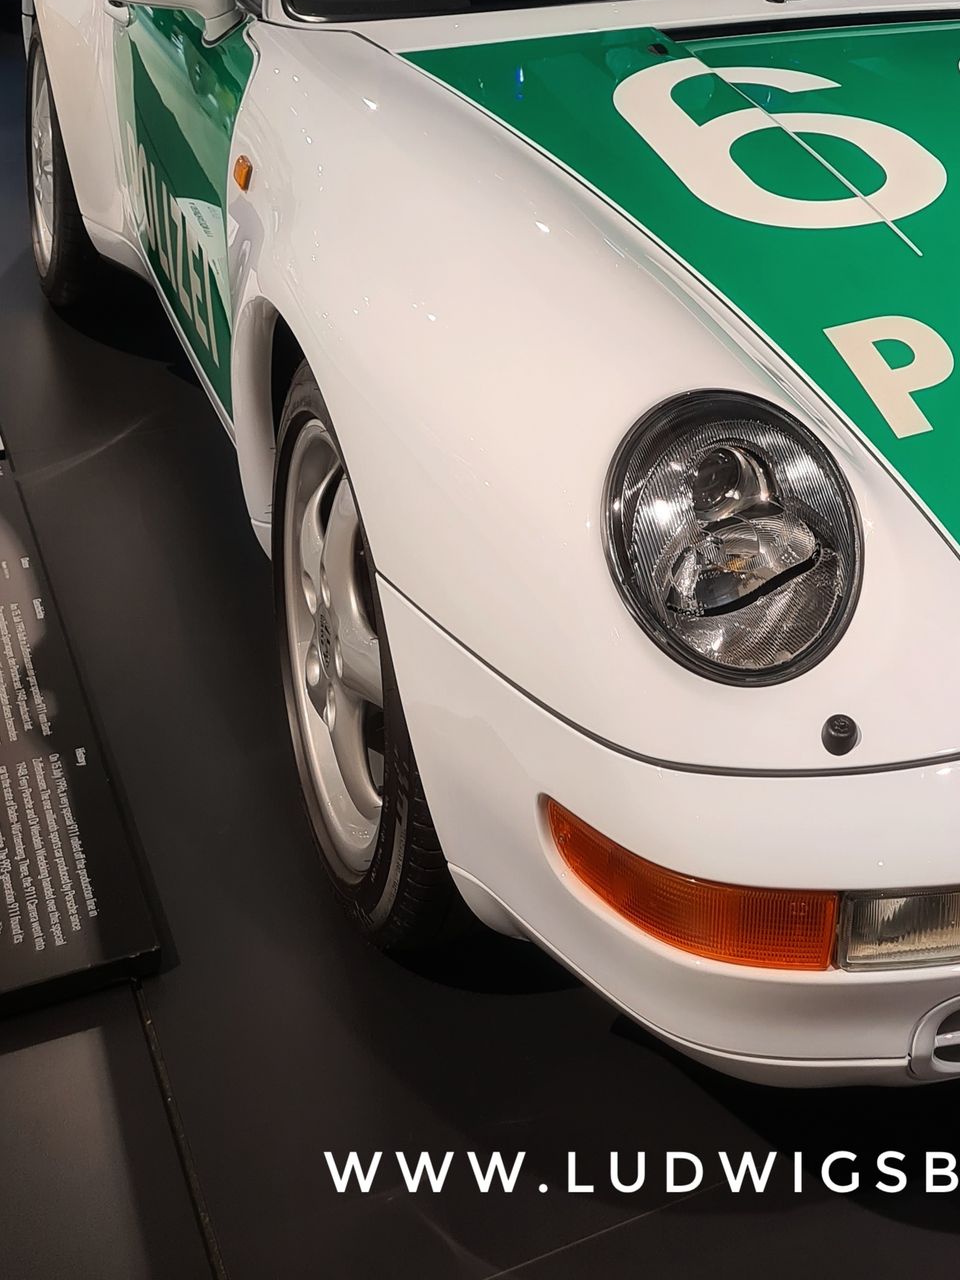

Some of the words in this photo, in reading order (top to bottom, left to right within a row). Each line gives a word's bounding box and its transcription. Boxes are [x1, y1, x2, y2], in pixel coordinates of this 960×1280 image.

[75, 747, 86, 766] History
[22, 788, 34, 809] Porsche
[60, 807, 76, 825] special
[67, 825, 79, 836] 911
[48, 832, 61, 849] sports
[70, 837, 83, 852] rolled
[54, 849, 63, 857] car
[54, 857, 72, 884] produced
[76, 859, 86, 869] the
[22, 877, 33, 887] the
[42, 877, 56, 899] handed
[60, 883, 72, 891] by
[75, 869, 94, 899] production
[24, 886, 36, 900] 911
[8, 903, 20, 916] 911
[46, 899, 56, 912] over
[64, 890, 78, 914] Porsche
[86, 898, 96, 910] line
[27, 899, 38, 922] Carrera
[89, 909, 99, 917] in
[70, 914, 81, 931] since
